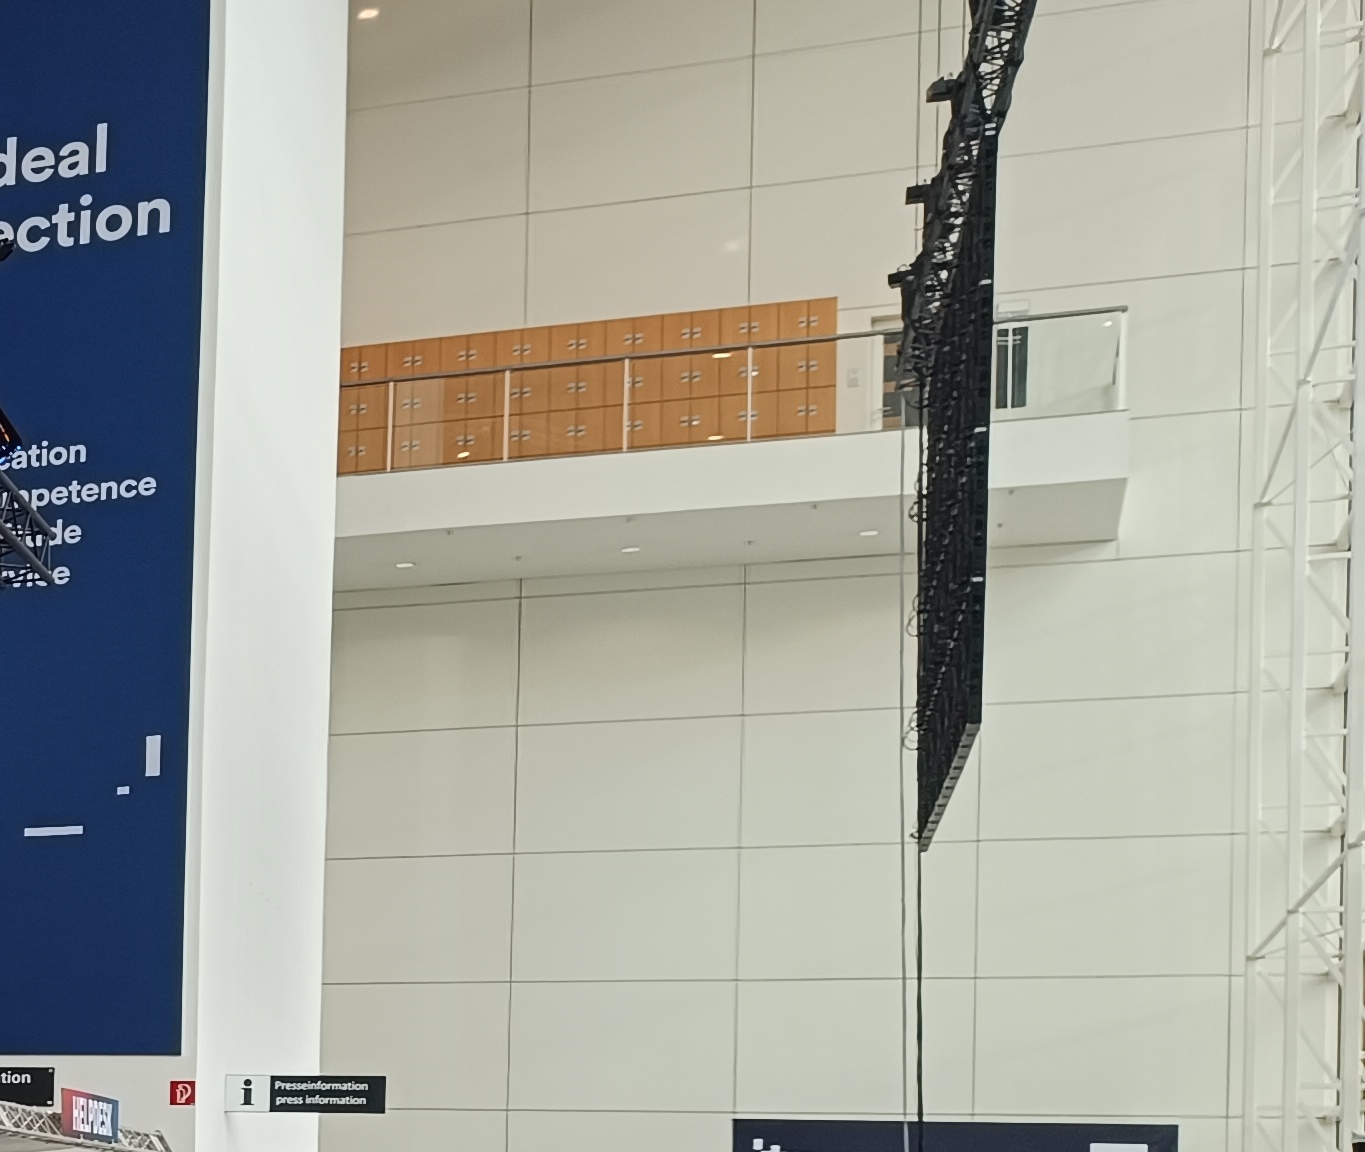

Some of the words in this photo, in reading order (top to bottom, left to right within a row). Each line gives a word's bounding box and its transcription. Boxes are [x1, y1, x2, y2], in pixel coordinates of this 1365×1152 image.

[274, 1080, 369, 1091] Presseinformation
[275, 1095, 304, 1106] press
[305, 1094, 367, 1105] information
[72, 1095, 114, 1137] HELPDESK
